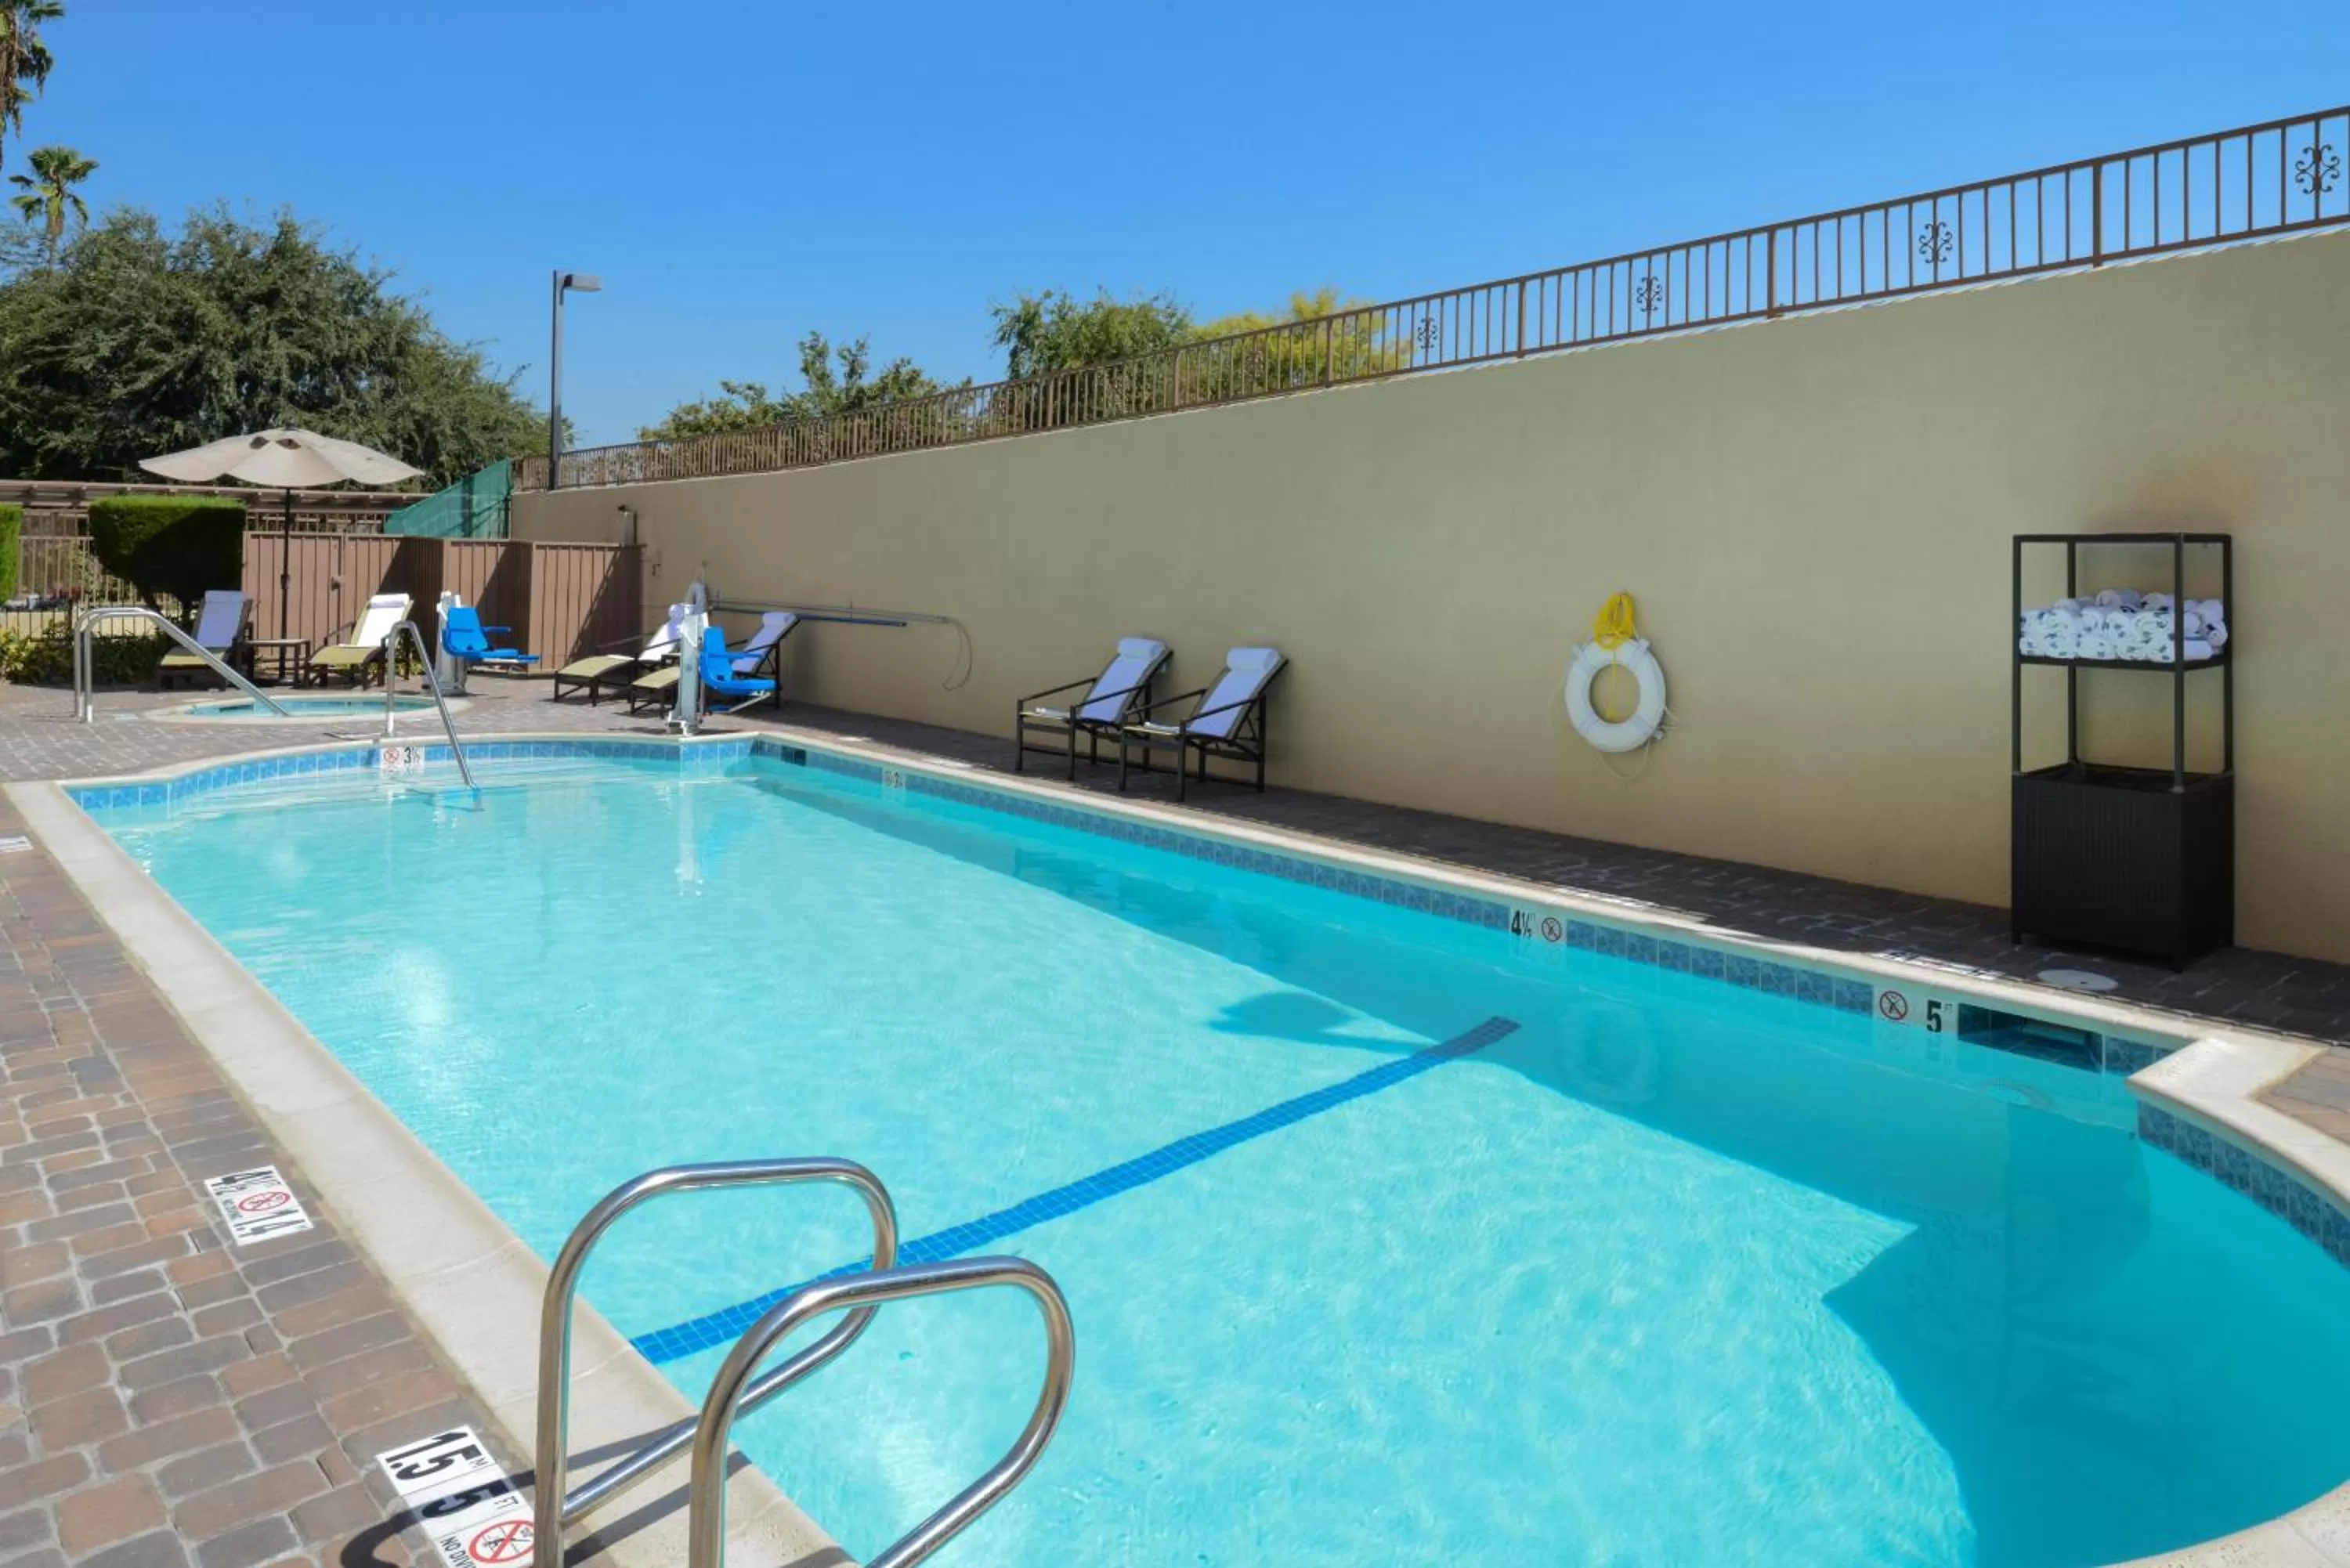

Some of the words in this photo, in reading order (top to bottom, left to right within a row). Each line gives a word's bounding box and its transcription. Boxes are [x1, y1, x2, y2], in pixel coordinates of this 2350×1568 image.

[1926, 999, 1942, 1032] 5
[385, 1432, 483, 1480] 1.5
[421, 1479, 510, 1518] 5
[440, 1536, 461, 1552] NO
